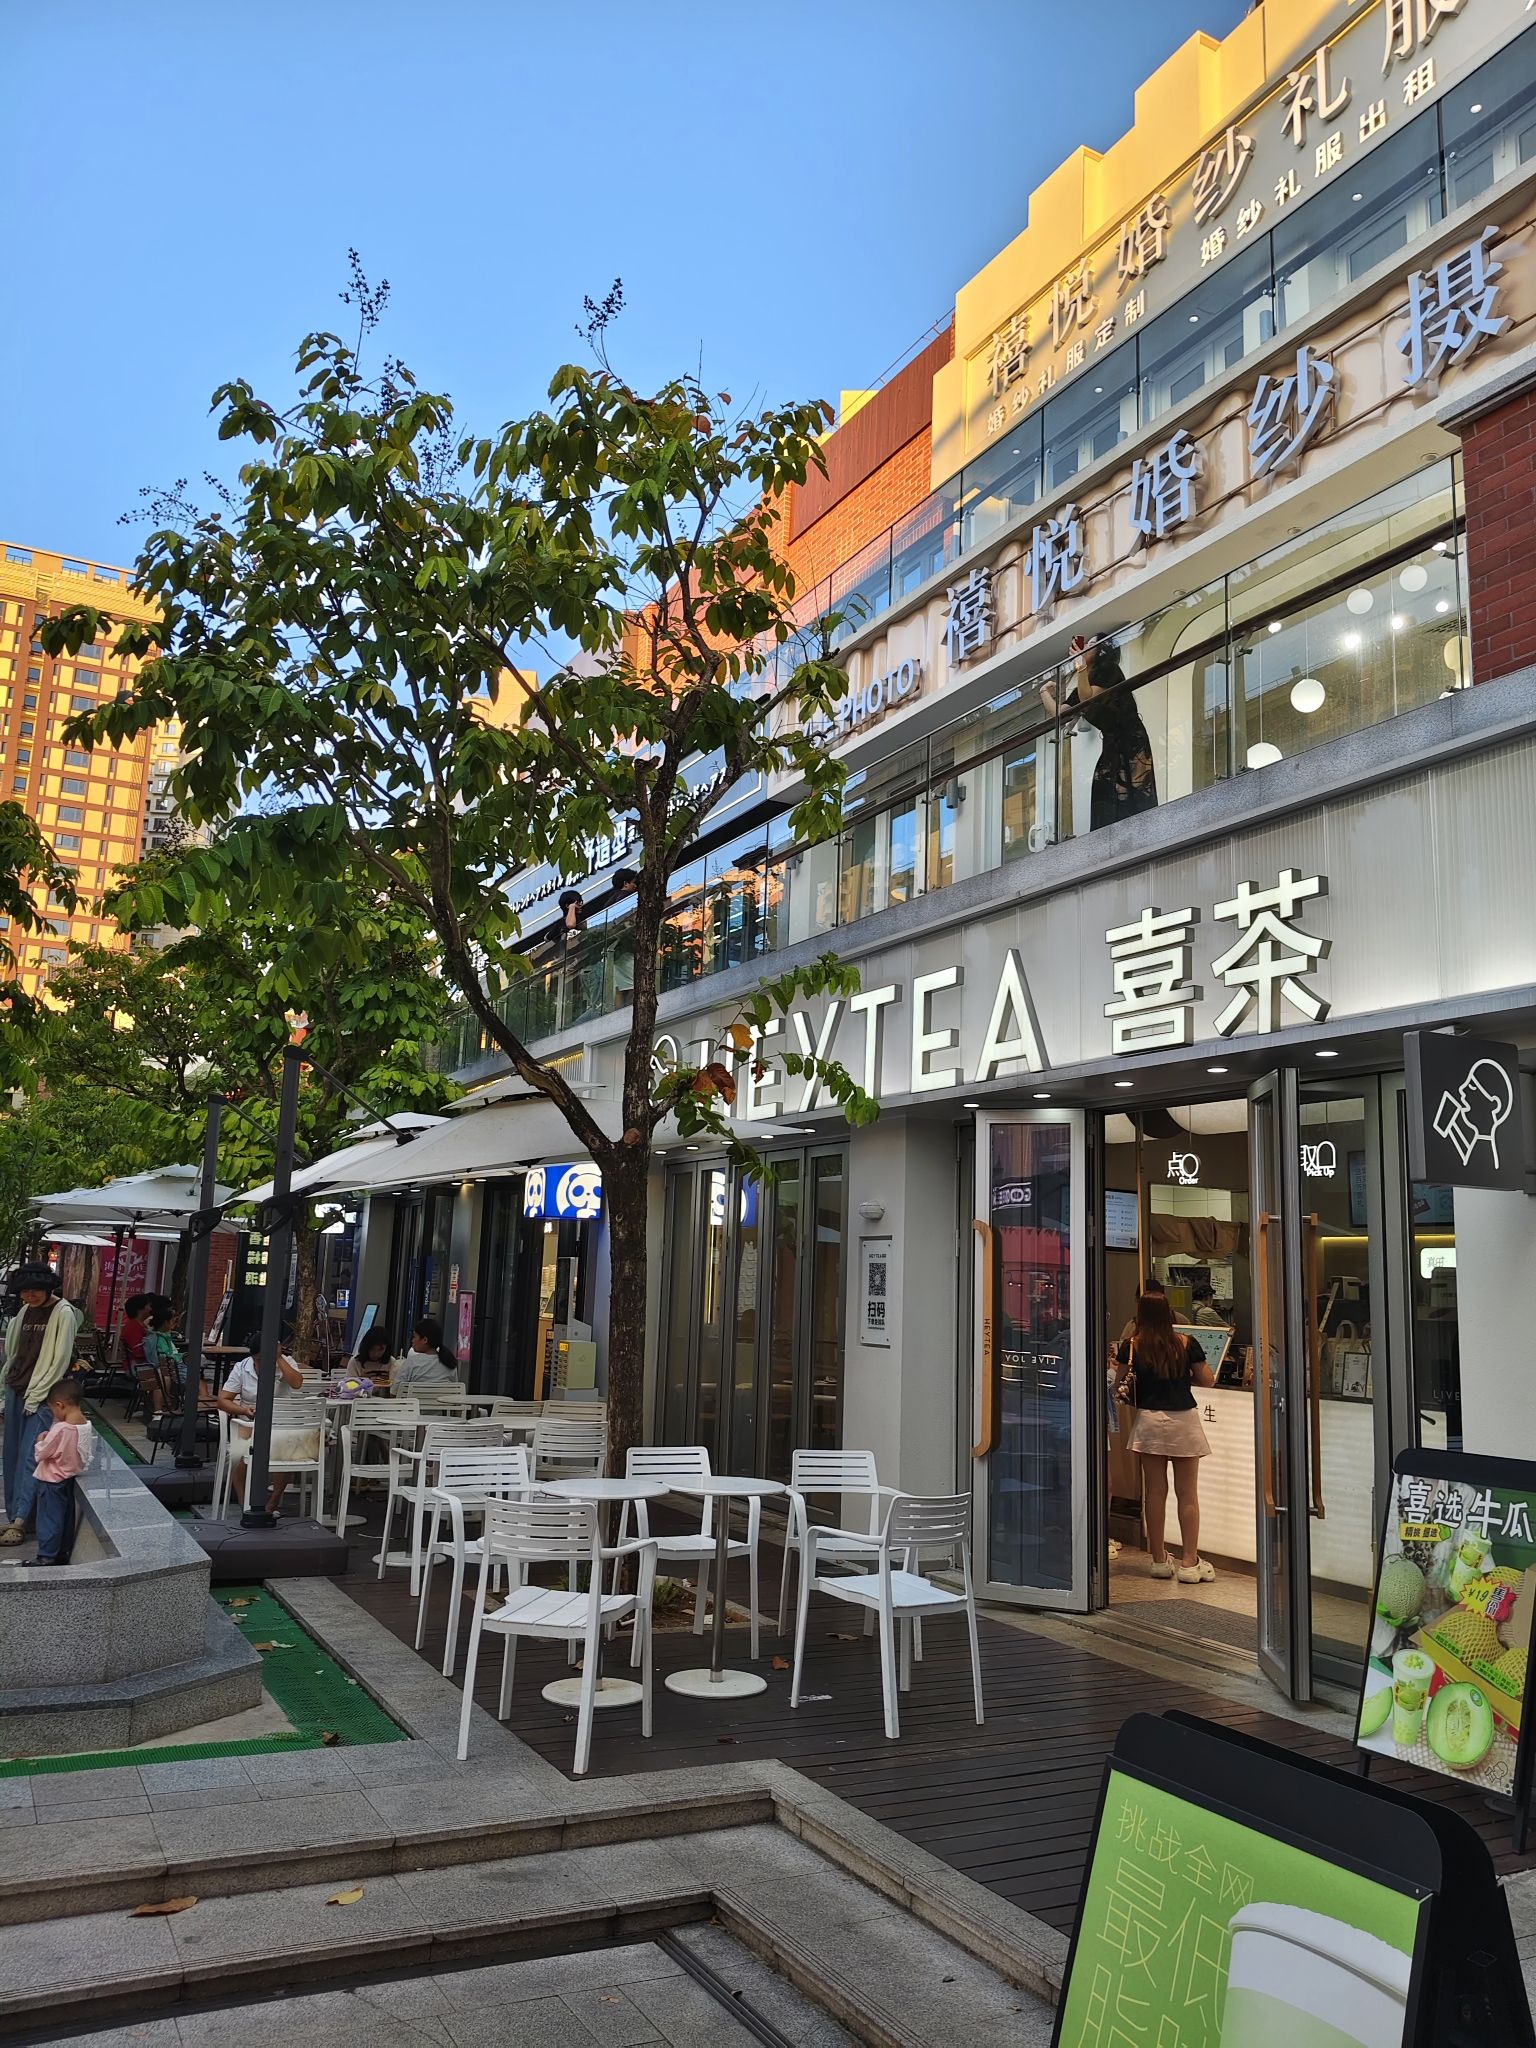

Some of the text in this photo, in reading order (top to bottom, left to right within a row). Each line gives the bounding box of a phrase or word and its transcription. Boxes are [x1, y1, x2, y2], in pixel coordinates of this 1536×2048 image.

[986, 57, 1437, 436] 婚纱礼服定制 婚纱礼服出租
[838, 658, 920, 735] PHOTO
[1105, 868, 1331, 1057] 喜茶
[1178, 1175, 1200, 1185] Order
[1306, 1168, 1335, 1178] Pick Up
[867, 1301, 886, 1318] 扫码
[984, 1318, 993, 1356] HEYTEA
[1203, 1404, 1217, 1423] 生
[1432, 1388, 1461, 1401] LIVE
[1403, 1479, 1535, 1543] 喜选牛瓜
[1468, 1589, 1489, 1602] ¥19
[1115, 1798, 1255, 1908] 挑战全网
[1096, 1856, 1229, 2036] 最低
